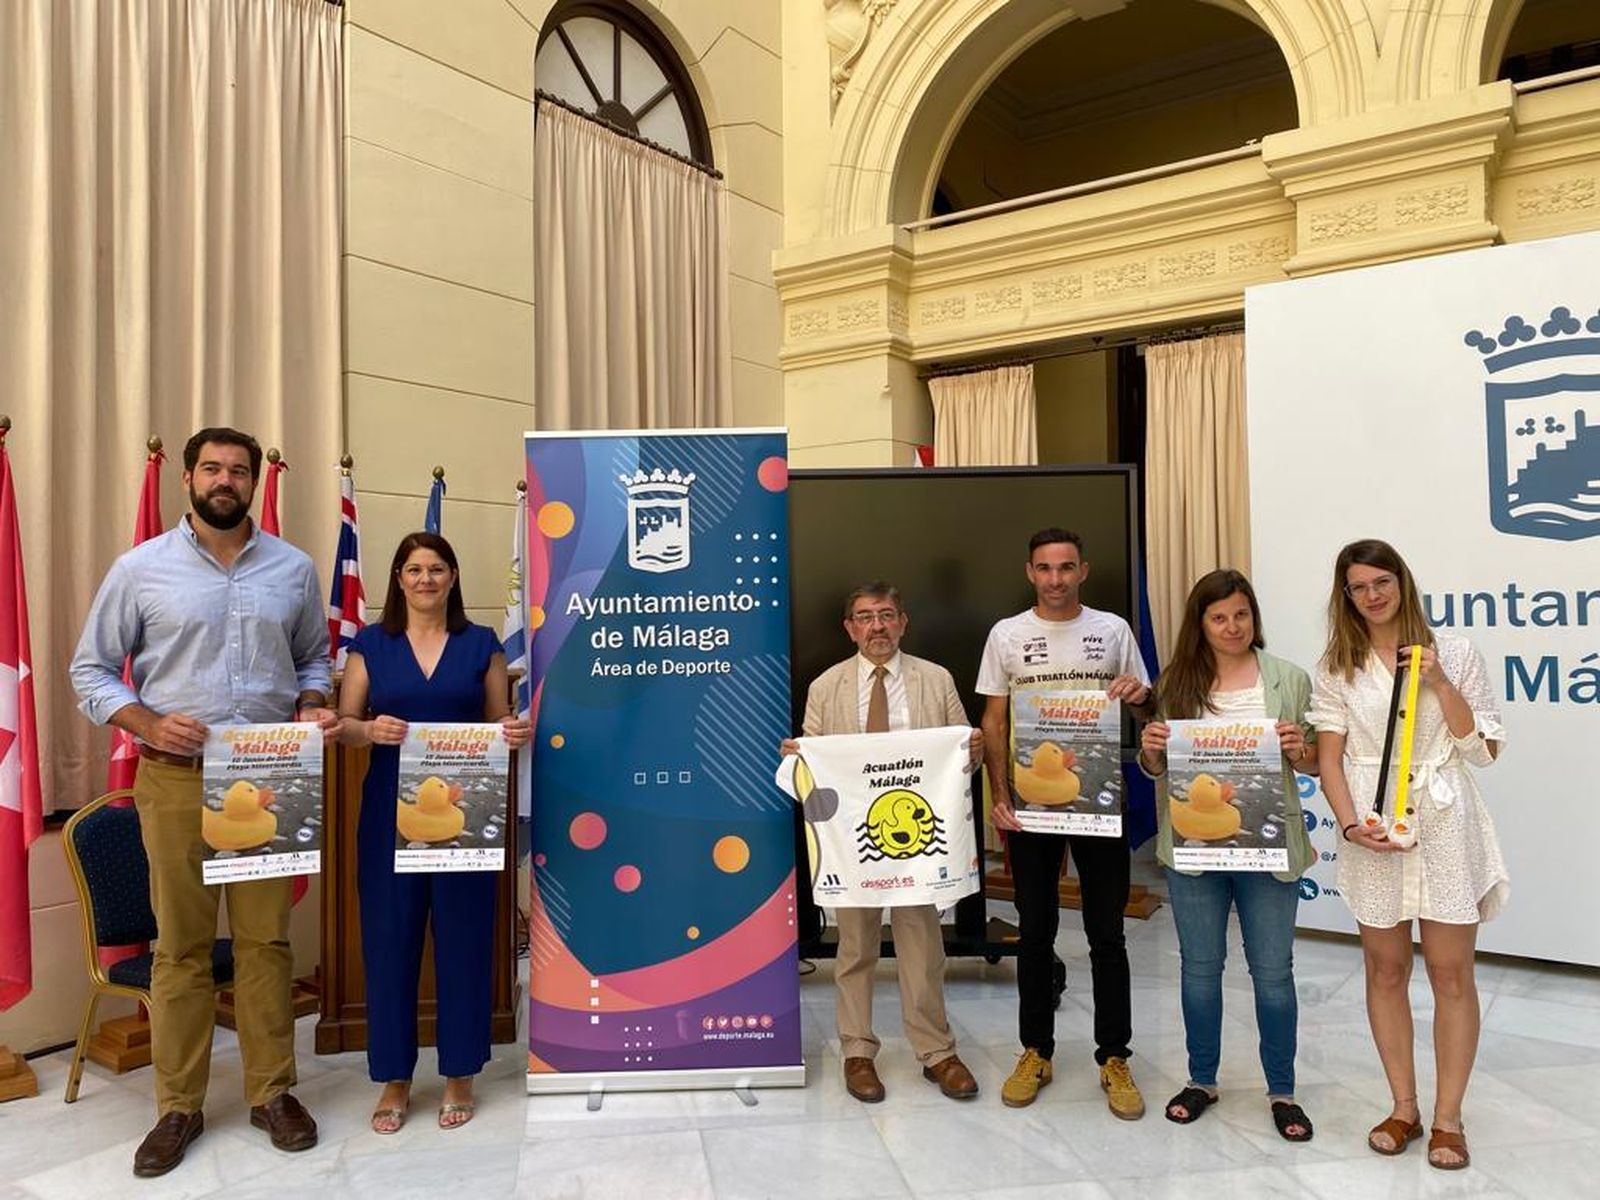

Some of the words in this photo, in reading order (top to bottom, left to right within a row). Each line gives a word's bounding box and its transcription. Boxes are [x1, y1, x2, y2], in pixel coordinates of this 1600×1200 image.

[565, 591, 753, 620] Ayuntamiento
[1423, 583, 1600, 627] unta
[590, 626, 624, 649] de
[632, 624, 730, 651] Málaga
[591, 657, 632, 676] Área
[636, 660, 657, 675] de
[661, 659, 731, 677] Deporte
[1036, 669, 1083, 682] TRIATLÓN
[1085, 669, 1115, 680] MÁLAG
[1029, 695, 1108, 709] Acuatlón
[1039, 707, 1100, 721] Málaga
[222, 727, 309, 741] Acuatlón
[416, 728, 497, 740] Acuatlón
[1183, 724, 1264, 737] Acuatlón
[231, 740, 301, 755] Málaga
[426, 740, 489, 754] Málaga
[1193, 736, 1258, 750] Málaga
[862, 758, 924, 774] Acuatlón
[869, 774, 921, 789] Málaga
